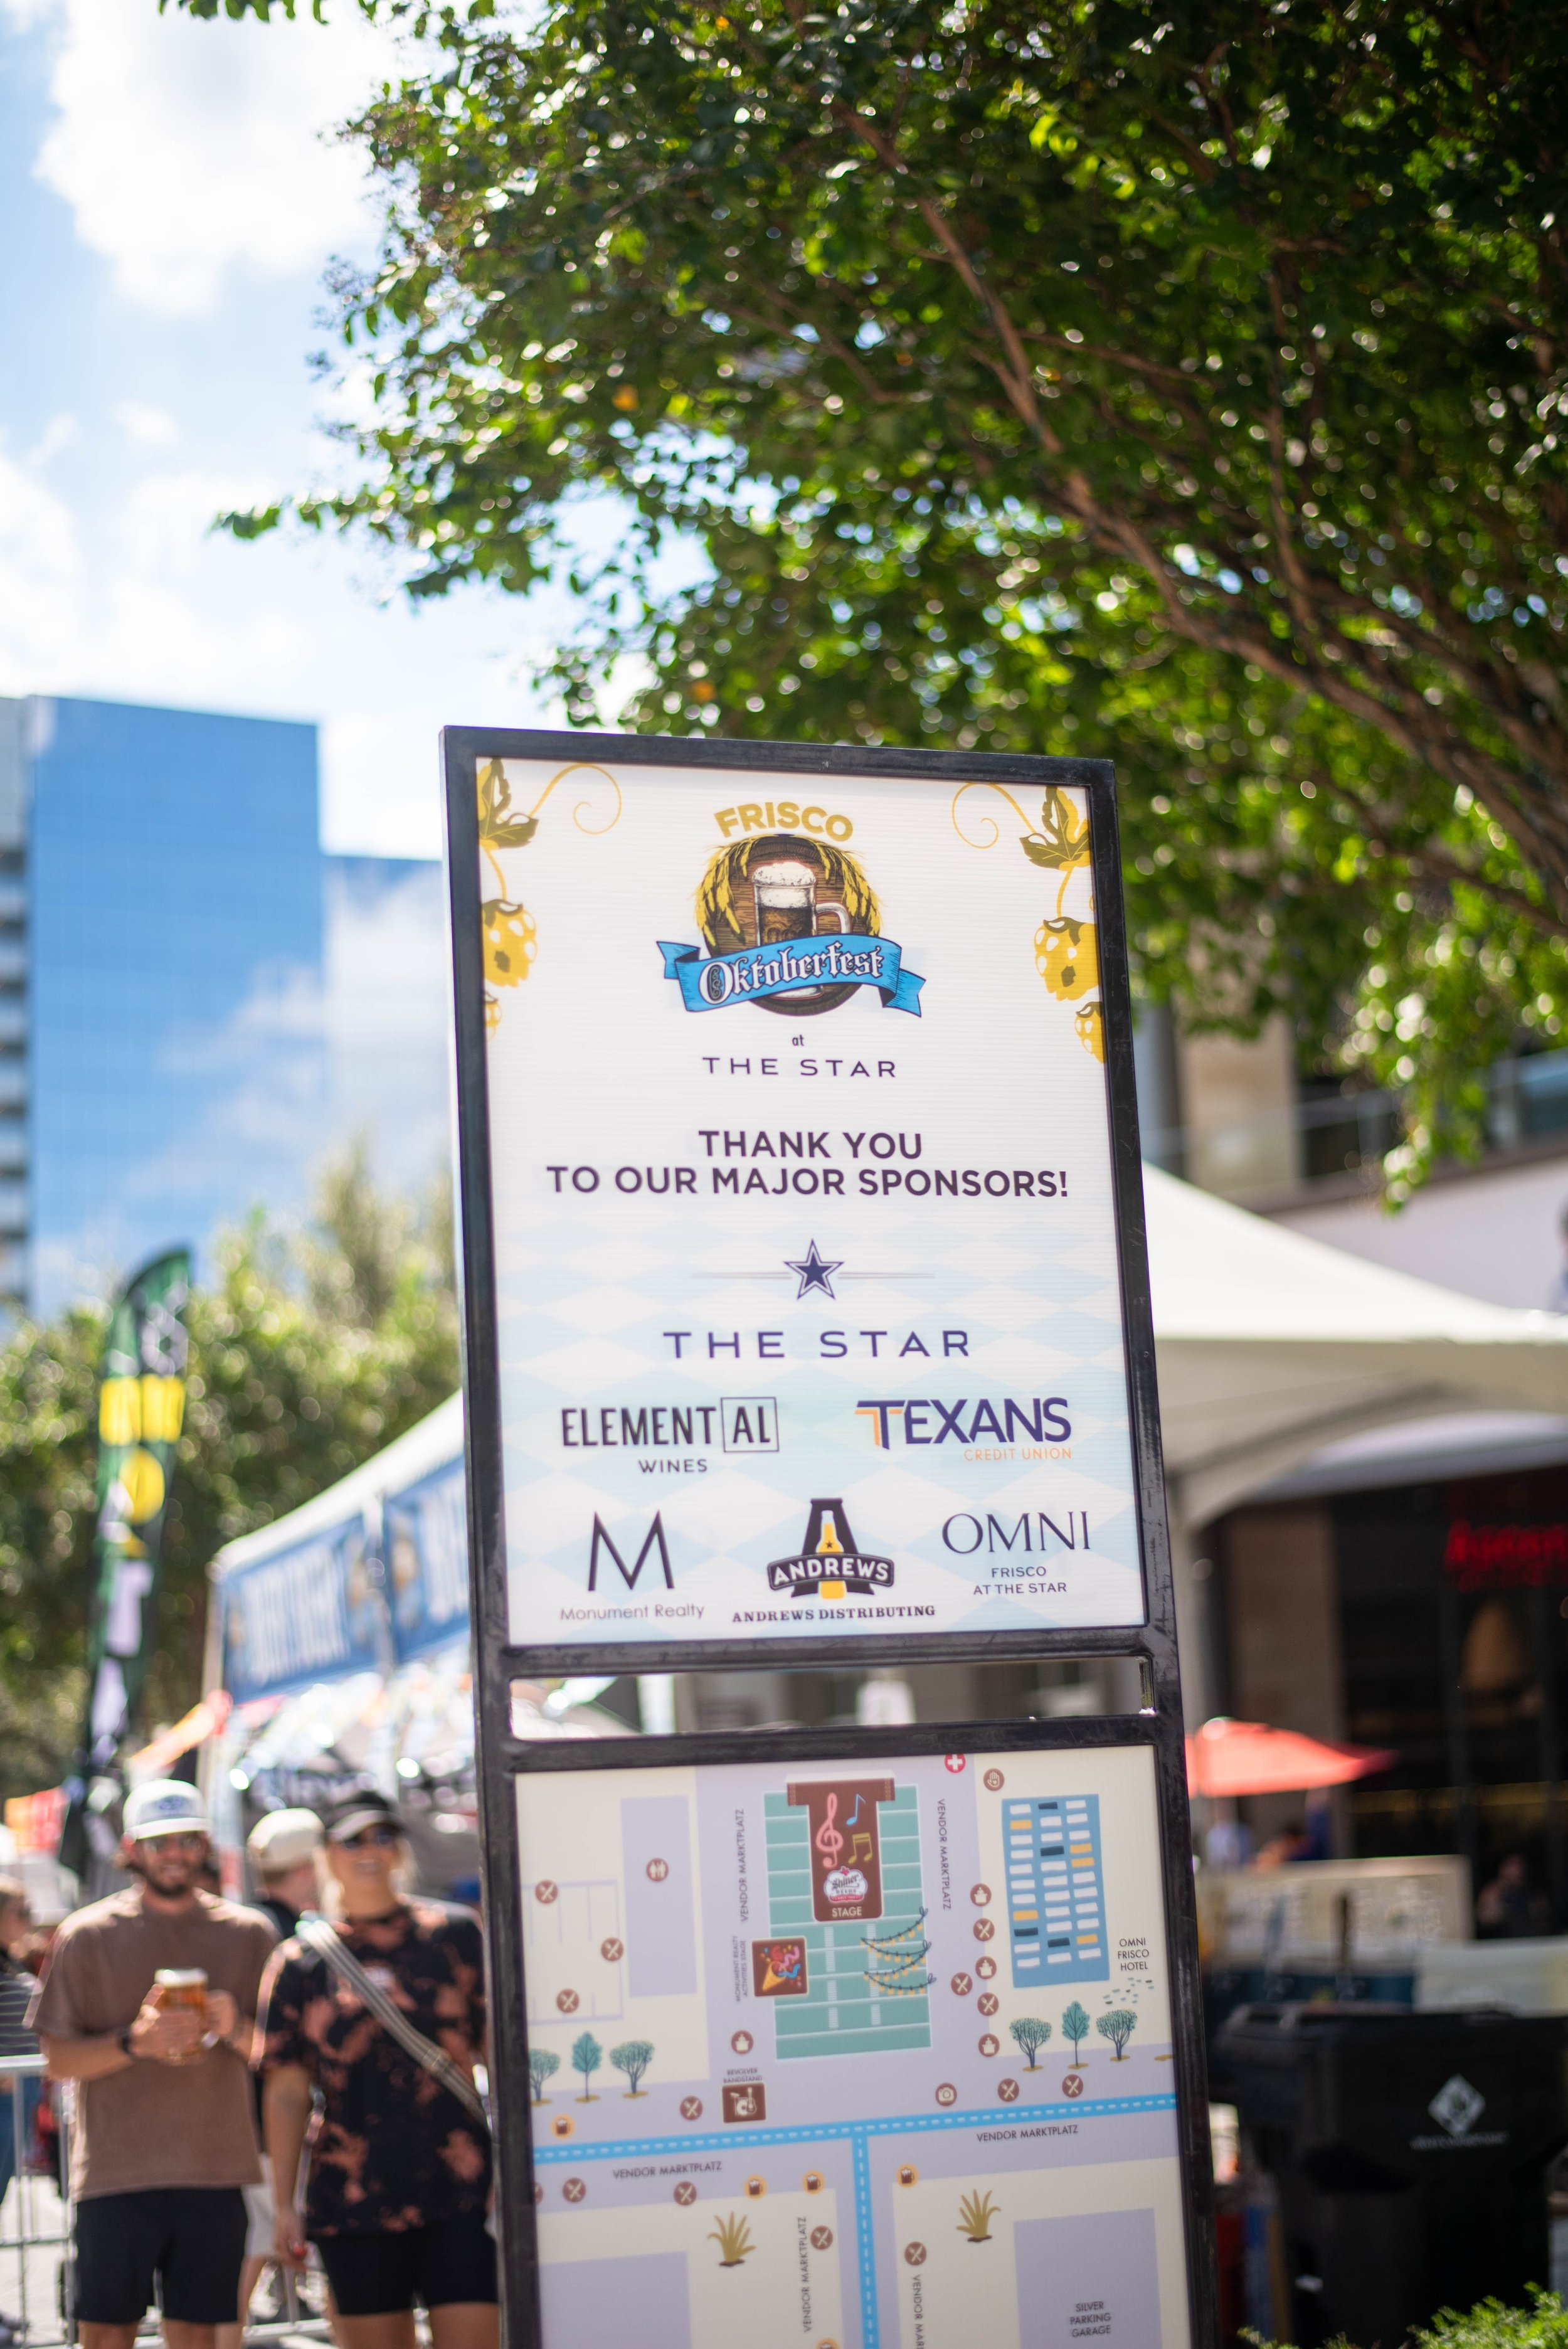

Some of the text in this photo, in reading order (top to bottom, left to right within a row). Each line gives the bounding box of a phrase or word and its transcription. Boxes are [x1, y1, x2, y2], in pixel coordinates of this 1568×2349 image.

[714, 802, 854, 842] FRISCO
[699, 941, 883, 1004] Oktoberfest
[792, 1034, 804, 1046] at
[702, 1058, 896, 1078] THE STAR
[699, 1130, 923, 1160] THANK YOU
[547, 1165, 1068, 1197] TO OUR MAJOR SPONSORS!
[662, 1330, 969, 1359] THE STAR
[854, 1397, 1071, 1450] TEXANS
[964, 1447, 1072, 1461] CREDIT UNION
[638, 1459, 708, 1473] WINES
[941, 1511, 1091, 1554] OMNI
[773, 1557, 889, 1586] ANDREWS
[992, 1566, 1047, 1578] FRISCO
[973, 1582, 1067, 1595] AT THE STAR
[560, 1603, 705, 1620] Monument Realty
[732, 1605, 935, 1623] ANDREWS DISTRIBUTING
[938, 1798, 951, 1910] VENDOR MARKTPLATZ
[736, 1809, 748, 1922] VENDOR MARKTPLATZ
[832, 1907, 862, 1917] STAGE
[1119, 1937, 1146, 1947] OMNI
[1118, 1949, 1149, 1959] FRISCO
[1120, 1961, 1148, 1971] HOTEL
[977, 2124, 1078, 2142] VENDOR MARKTPLATZ
[612, 2161, 722, 2178] VENDOR MARKTPLATZ
[798, 2217, 812, 2333] VENDOR MARKTPLATZ
[913, 2274, 924, 2349] VENDOR MAR
[1075, 2301, 1104, 2312] SILVER
[1069, 2313, 1111, 2325] PARKING
[1071, 2325, 1111, 2337] GARAGE
